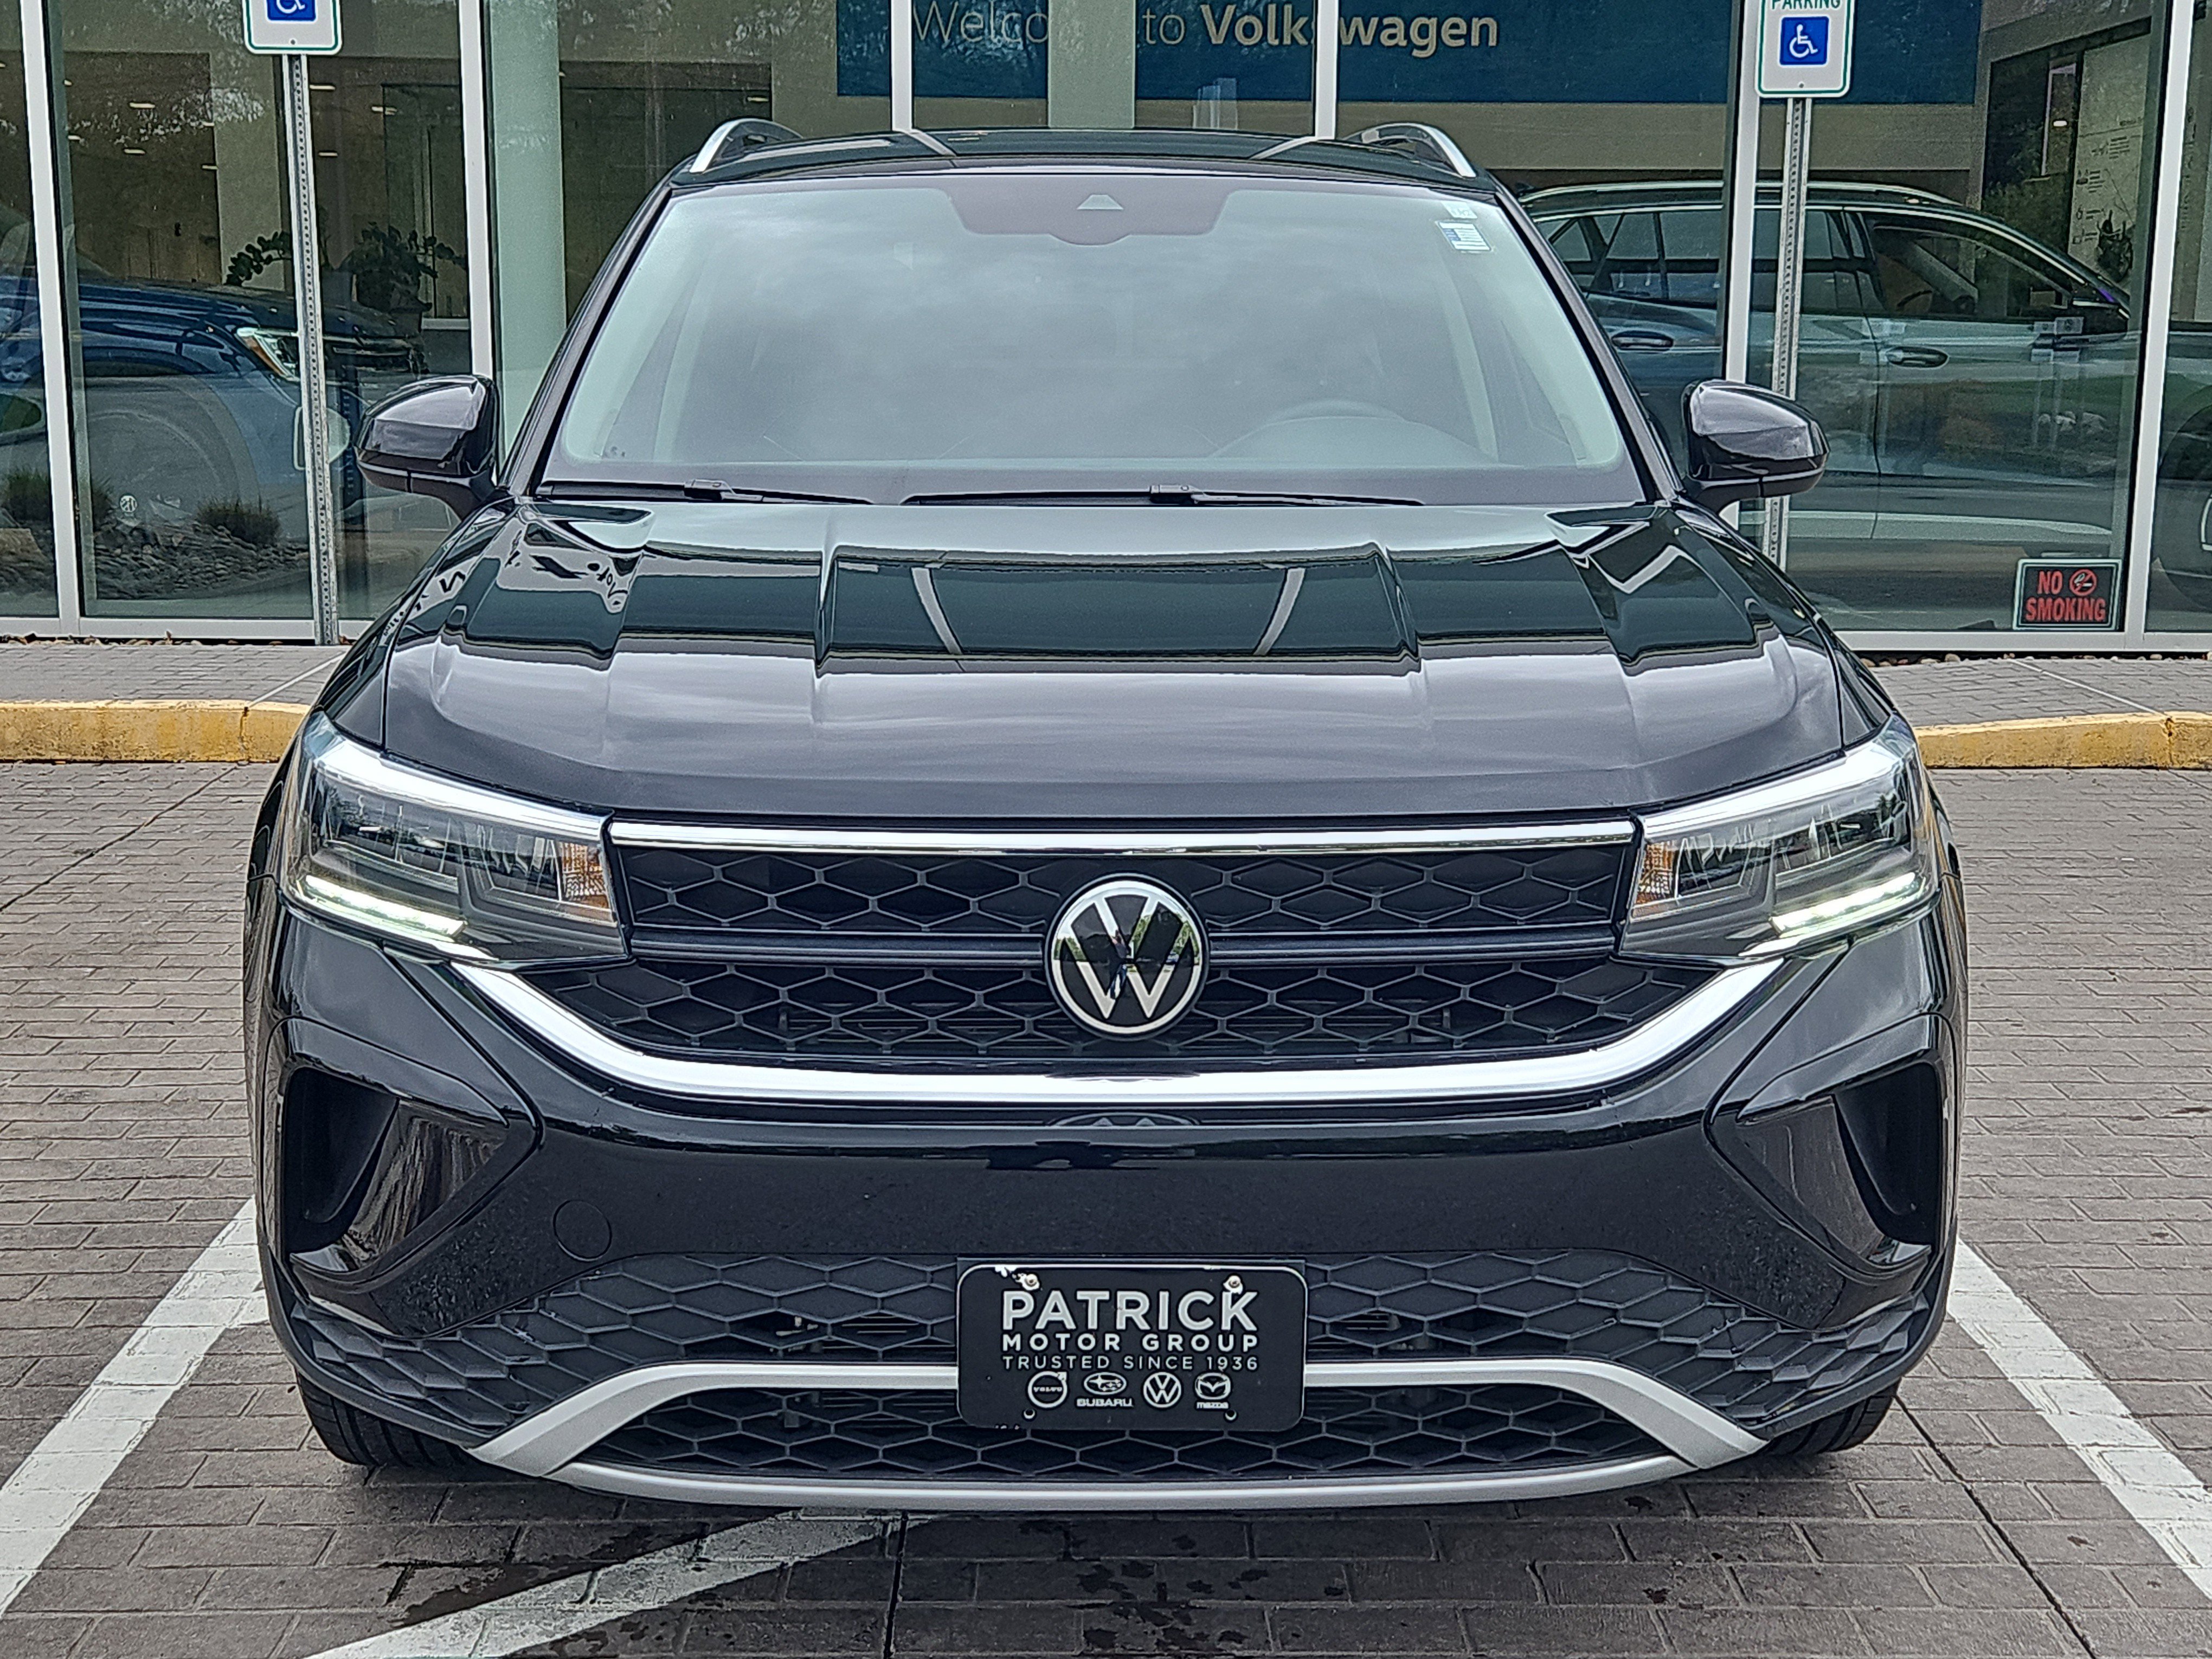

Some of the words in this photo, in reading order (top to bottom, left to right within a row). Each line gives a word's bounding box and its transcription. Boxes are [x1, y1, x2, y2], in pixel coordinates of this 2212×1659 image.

[913, 1, 1049, 44] Welco
[1142, 8, 1186, 46] to
[1201, 4, 1497, 58] Volkwagen
[2037, 570, 2063, 595] NO
[2025, 597, 2106, 622] SMOKING
[1002, 1290, 1258, 1331] PATRICK
[1003, 1333, 1121, 1352] MOTOR
[1142, 1333, 1258, 1352] GROUP
[1002, 1355, 1110, 1369] TRUSTED
[1123, 1356, 1193, 1370] SINCE
[1206, 1356, 1258, 1371] 1936
[1076, 1398, 1133, 1407] SUBARU
